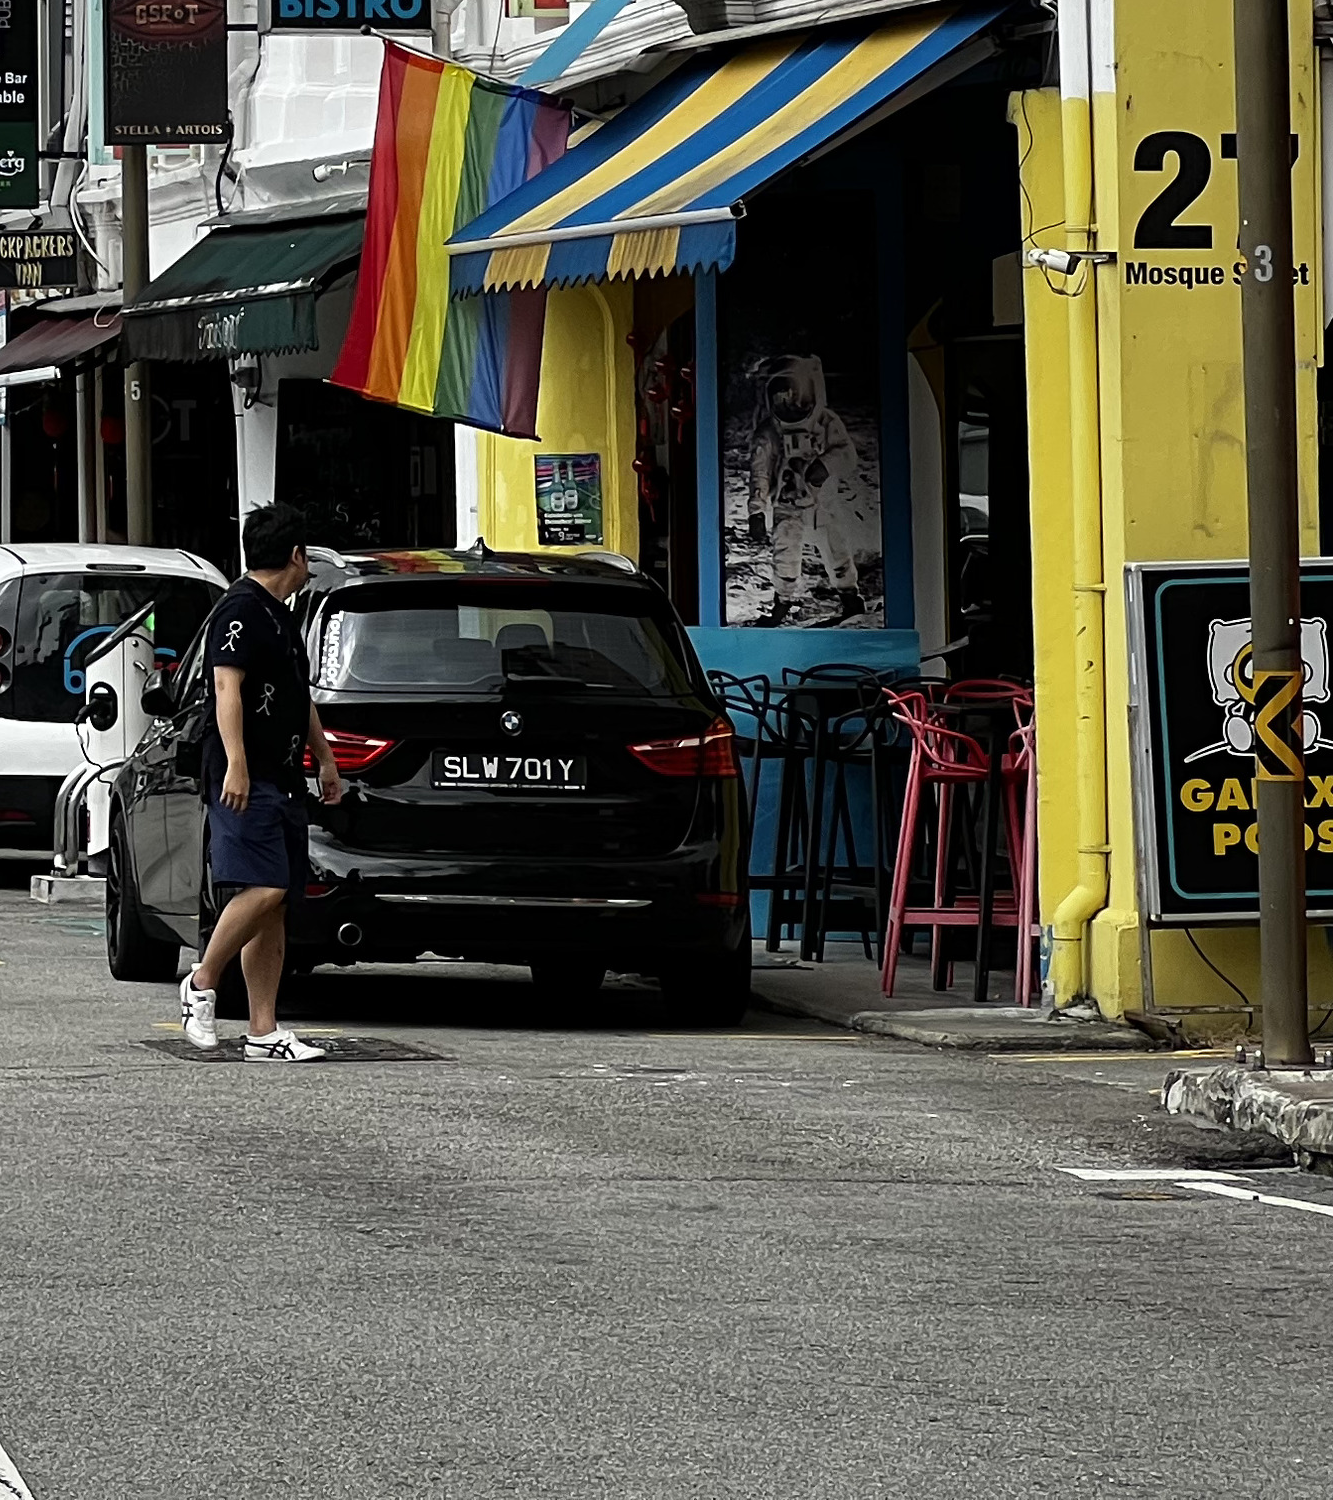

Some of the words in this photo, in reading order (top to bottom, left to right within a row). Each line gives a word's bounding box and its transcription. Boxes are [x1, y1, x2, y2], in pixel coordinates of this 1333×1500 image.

[5, 73, 27, 85] Bar
[115, 125, 161, 135] STELLA
[175, 124, 223, 135] ARTOIS
[1254, 245, 1273, 282] 3
[1125, 262, 1224, 289] Mosque
[130, 381, 141, 400] 5
